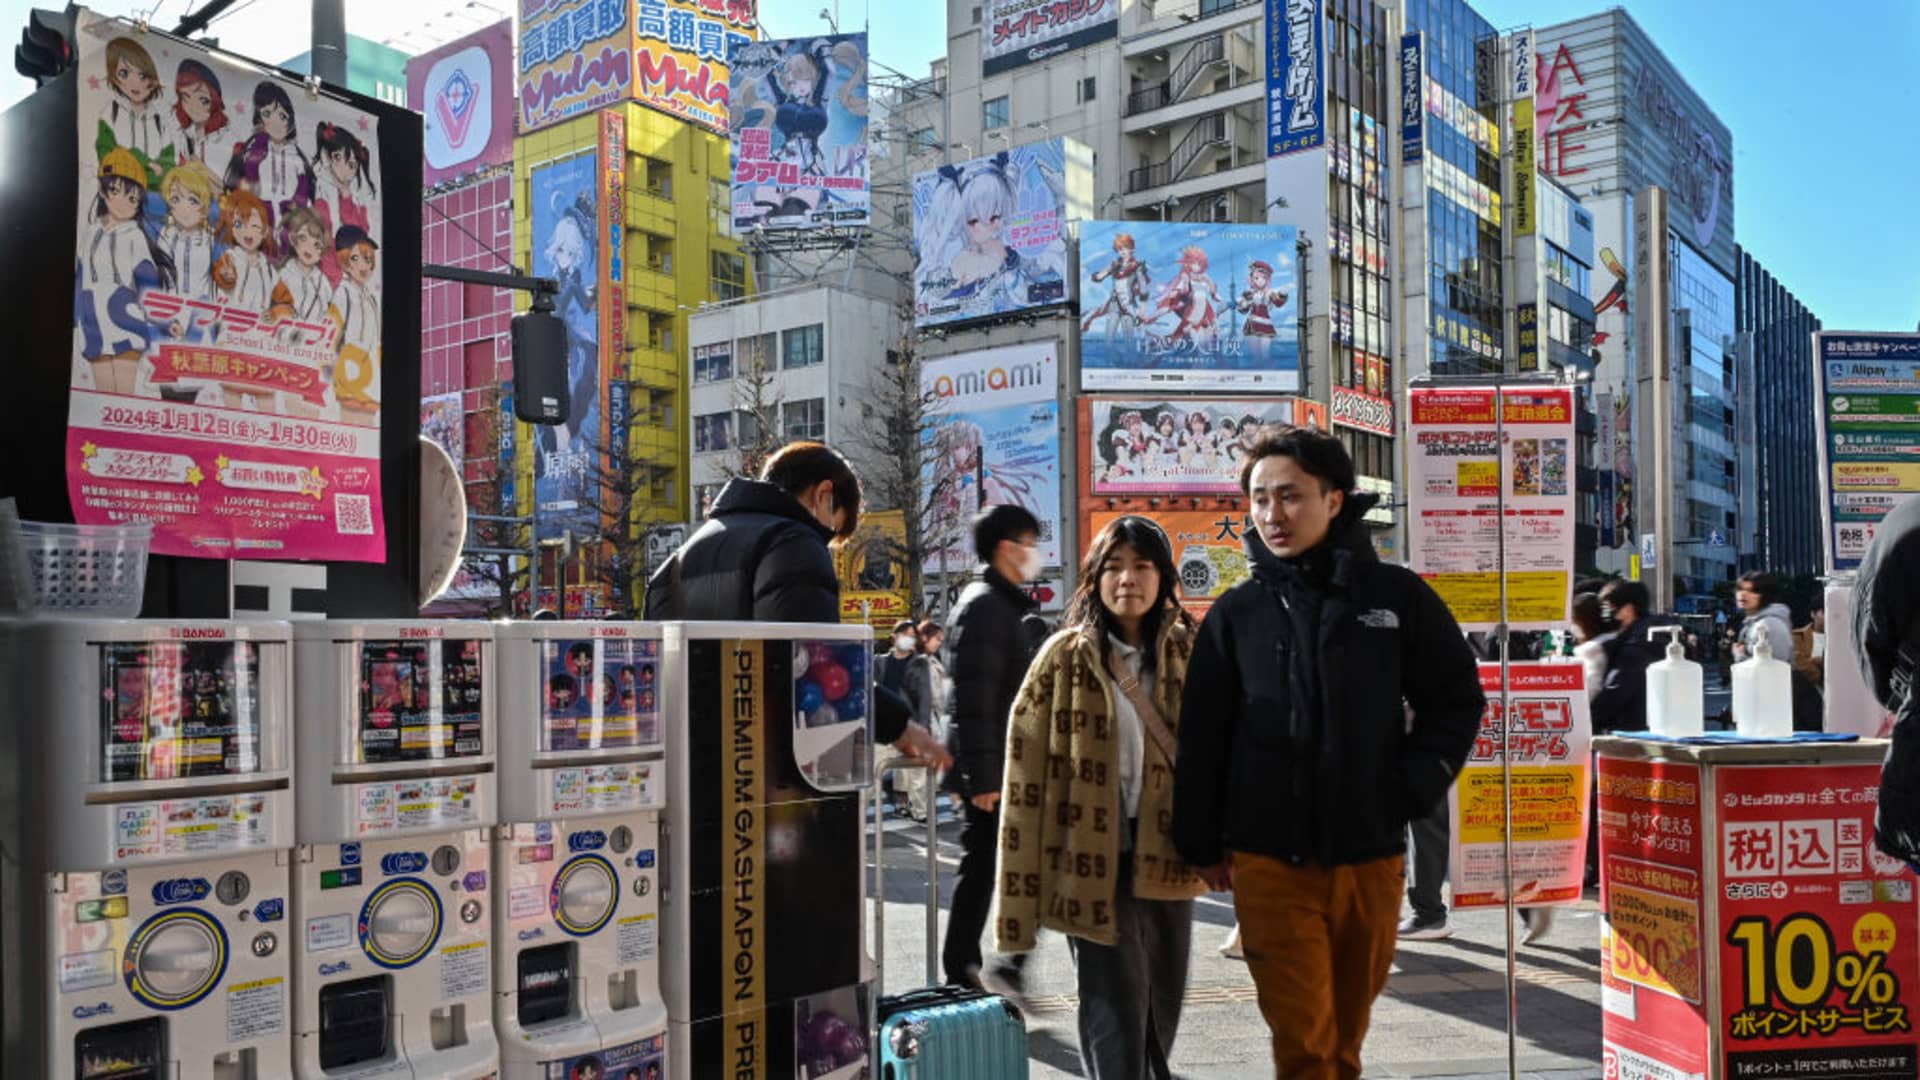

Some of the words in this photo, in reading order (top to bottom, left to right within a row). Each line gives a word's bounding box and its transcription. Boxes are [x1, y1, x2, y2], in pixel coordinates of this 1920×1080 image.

[521, 46, 629, 125] Mulan
[170, 350, 313, 389] 秋葉原キャンペーン
[935, 360, 1042, 398] amiami
[1852, 363, 1887, 377] Alipay
[183, 628, 226, 638] BANDAI
[731, 649, 755, 813] PREMIUM
[1729, 828, 1831, 872] 税込
[732, 816, 755, 1002] GASHAPON
[1727, 883, 1770, 898] さらに
[1859, 928, 1891, 942] 基本
[1730, 915, 1897, 1008] 10%
[1732, 1006, 1909, 1037] ポイントサービス
